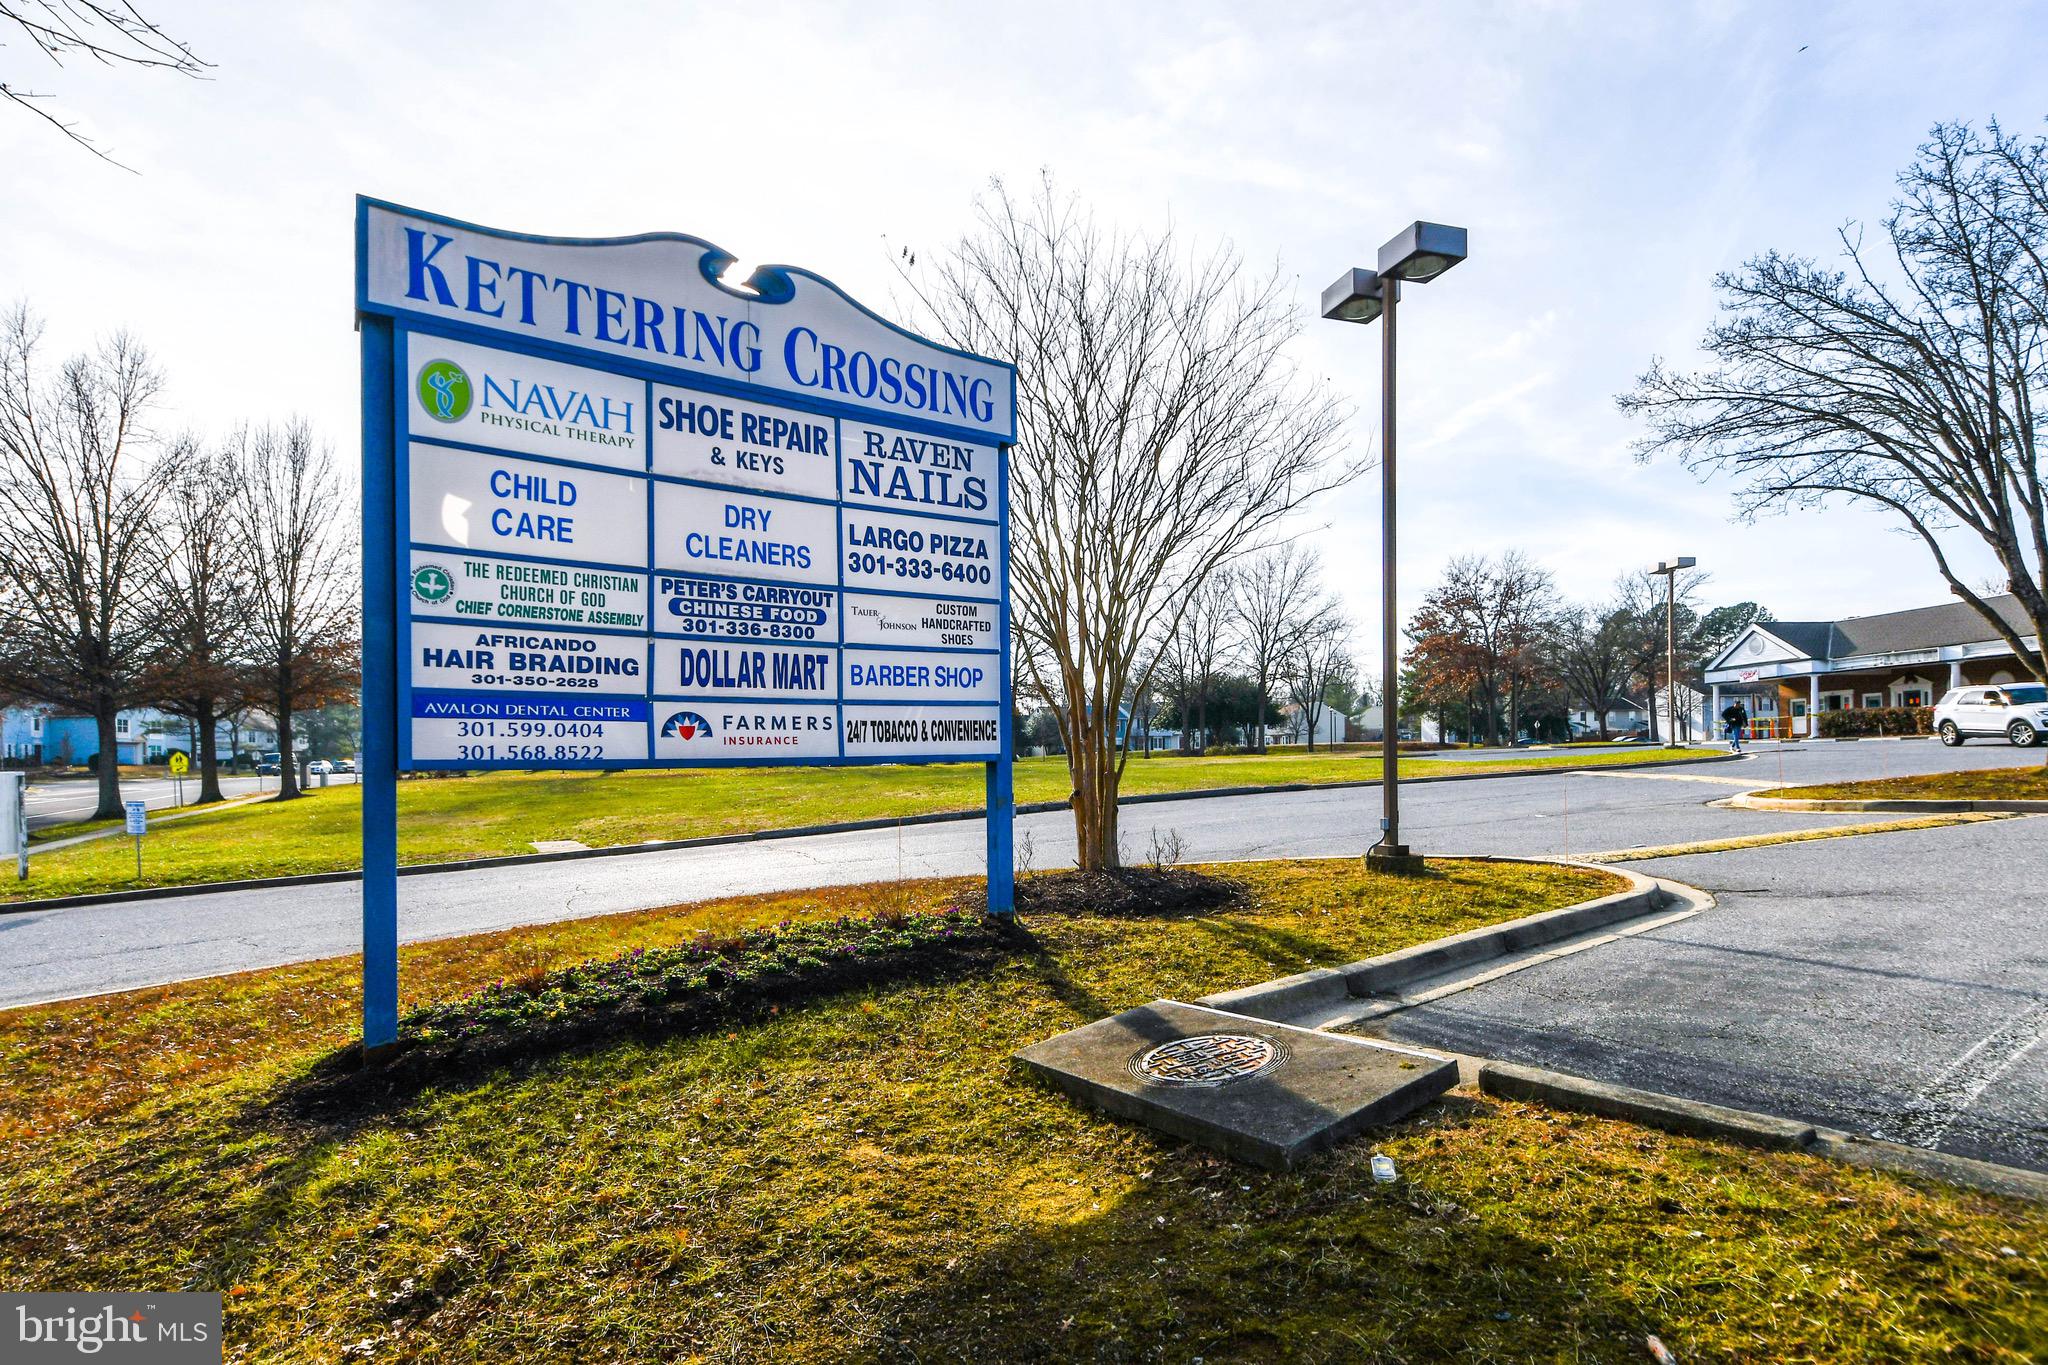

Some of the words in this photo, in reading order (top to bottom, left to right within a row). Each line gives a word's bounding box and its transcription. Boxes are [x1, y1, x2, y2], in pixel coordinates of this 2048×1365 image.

[404, 227, 763, 373] KETTERING
[783, 326, 994, 423] CROSSING
[480, 373, 634, 434] NAVAH
[480, 412, 561, 437] PHYSICAL
[566, 427, 635, 449] THERAPY
[658, 396, 734, 441] SHOE
[741, 412, 829, 457] REPAIR
[710, 446, 726, 466] &
[736, 450, 785, 475] KEYS
[863, 430, 974, 472] RAVEN
[490, 469, 577, 507] CHILD
[848, 458, 988, 511] NAILS
[491, 508, 574, 544] CARE
[725, 504, 772, 532] DRY
[685, 532, 811, 569] CLEANERS
[849, 524, 924, 552] LARGO
[930, 533, 989, 560] PIZZA
[464, 561, 490, 579] THE
[496, 565, 568, 587] REDEEMED
[573, 572, 639, 593] CHRISTIAN
[848, 552, 991, 585] 301-333-6400
[501, 584, 554, 603] CHURCH
[560, 590, 577, 605] OF
[582, 593, 606, 608] GOD
[661, 578, 738, 600] PETER'S
[743, 585, 834, 608] CARRYOUT
[456, 600, 493, 615] CHIEF
[498, 603, 583, 622] CORNERSTONE
[587, 611, 644, 627] ASSEMBLY
[679, 600, 764, 620] CHINESE
[770, 608, 818, 623] FOOD
[921, 617, 991, 632] HANDCRAFTED
[936, 604, 978, 617] CUSTOM
[682, 618, 815, 639] 301-336-8300
[941, 634, 974, 646] SHOES
[476, 634, 597, 652] AFRICANDO
[423, 648, 494, 670] HAIR
[509, 652, 639, 676] BRAIDING
[680, 648, 766, 689] DOLLAR
[773, 653, 829, 690] MART
[850, 664, 930, 687] BARBER
[934, 666, 983, 688] SHOP
[471, 674, 599, 688] 301-350-2628
[425, 703, 499, 715] AVALON
[506, 704, 568, 717] DENTAL
[573, 706, 631, 718] CENTER
[723, 715, 833, 731] FARMERS
[457, 721, 604, 738] 301.599.0404
[723, 736, 799, 746] INSURANCE
[847, 720, 868, 743] 24/7
[870, 720, 918, 743] TOBACCO
[921, 720, 929, 742] &
[930, 719, 997, 742] CONVENIENCE
[457, 745, 604, 760] 301.568.8522
